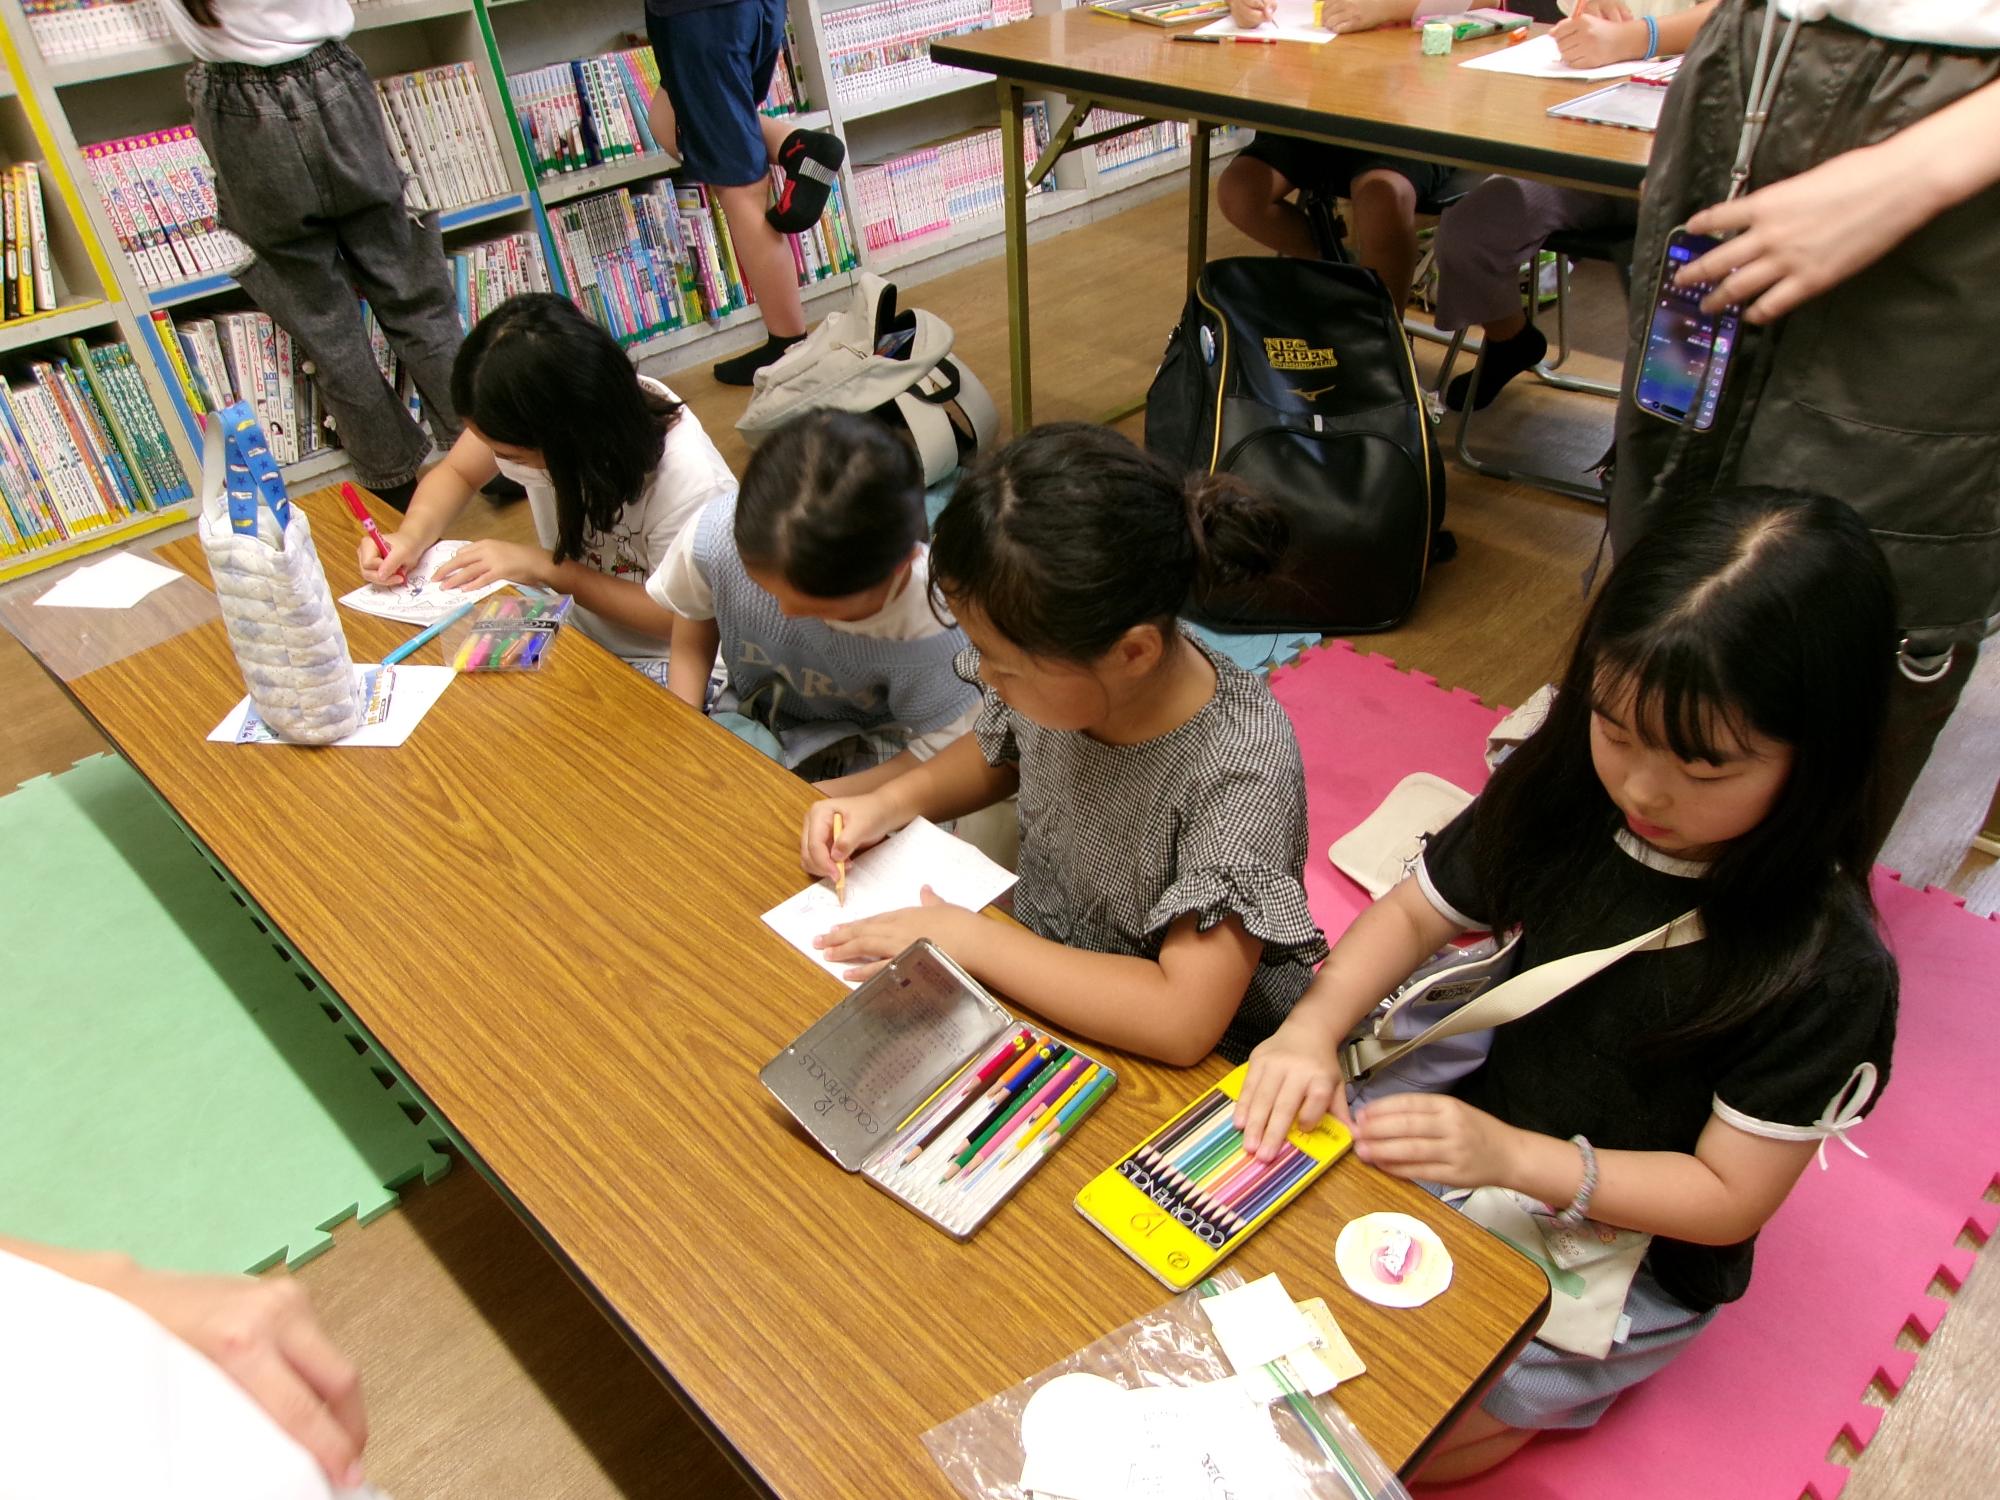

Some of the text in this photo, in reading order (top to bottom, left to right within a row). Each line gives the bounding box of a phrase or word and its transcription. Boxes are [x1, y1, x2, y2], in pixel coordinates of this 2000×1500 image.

[1269, 349, 1334, 362] GREEN
[798, 1054, 879, 1134] COLOR PENCILS
[813, 1094, 835, 1116] 12
[1118, 1159, 1226, 1249] COLOR PENCILS
[1130, 1211, 1167, 1238] 12
